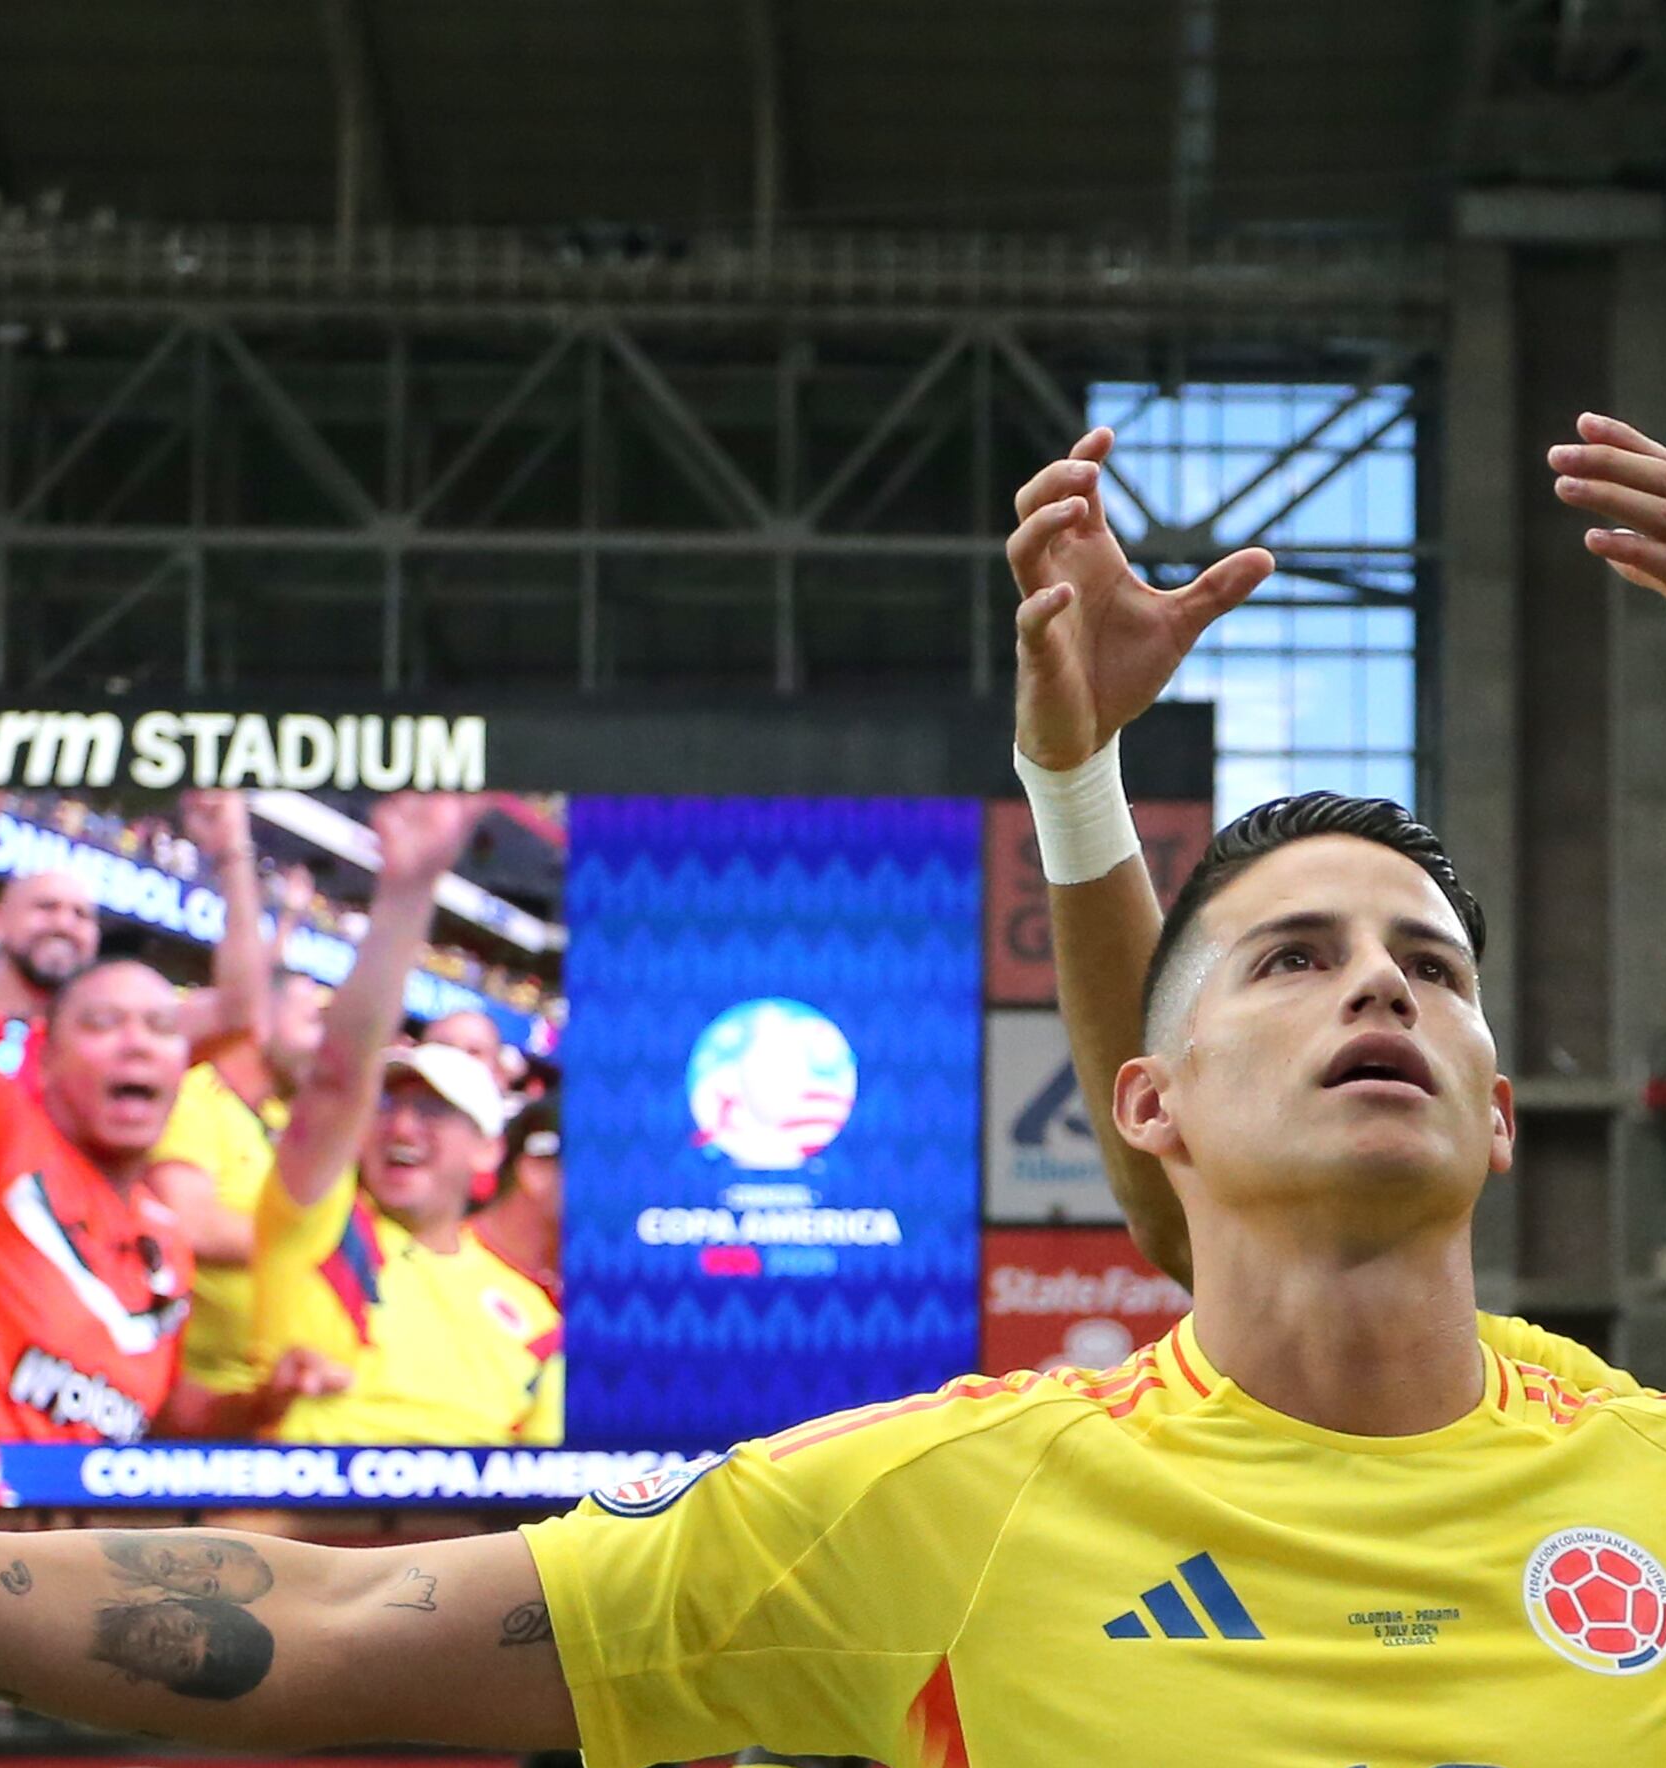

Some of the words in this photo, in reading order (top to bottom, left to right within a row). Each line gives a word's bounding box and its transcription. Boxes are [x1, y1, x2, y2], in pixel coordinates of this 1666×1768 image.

[130, 713, 486, 791] STADIUM
[636, 1206, 737, 1246] COPA
[80, 1447, 345, 1498] CONMEBOL
[345, 1448, 483, 1498] COPA
[1347, 1610, 1403, 1625] COLOMBIA
[1415, 1608, 1460, 1622] PANAMA
[1385, 1624, 1409, 1637] JULY
